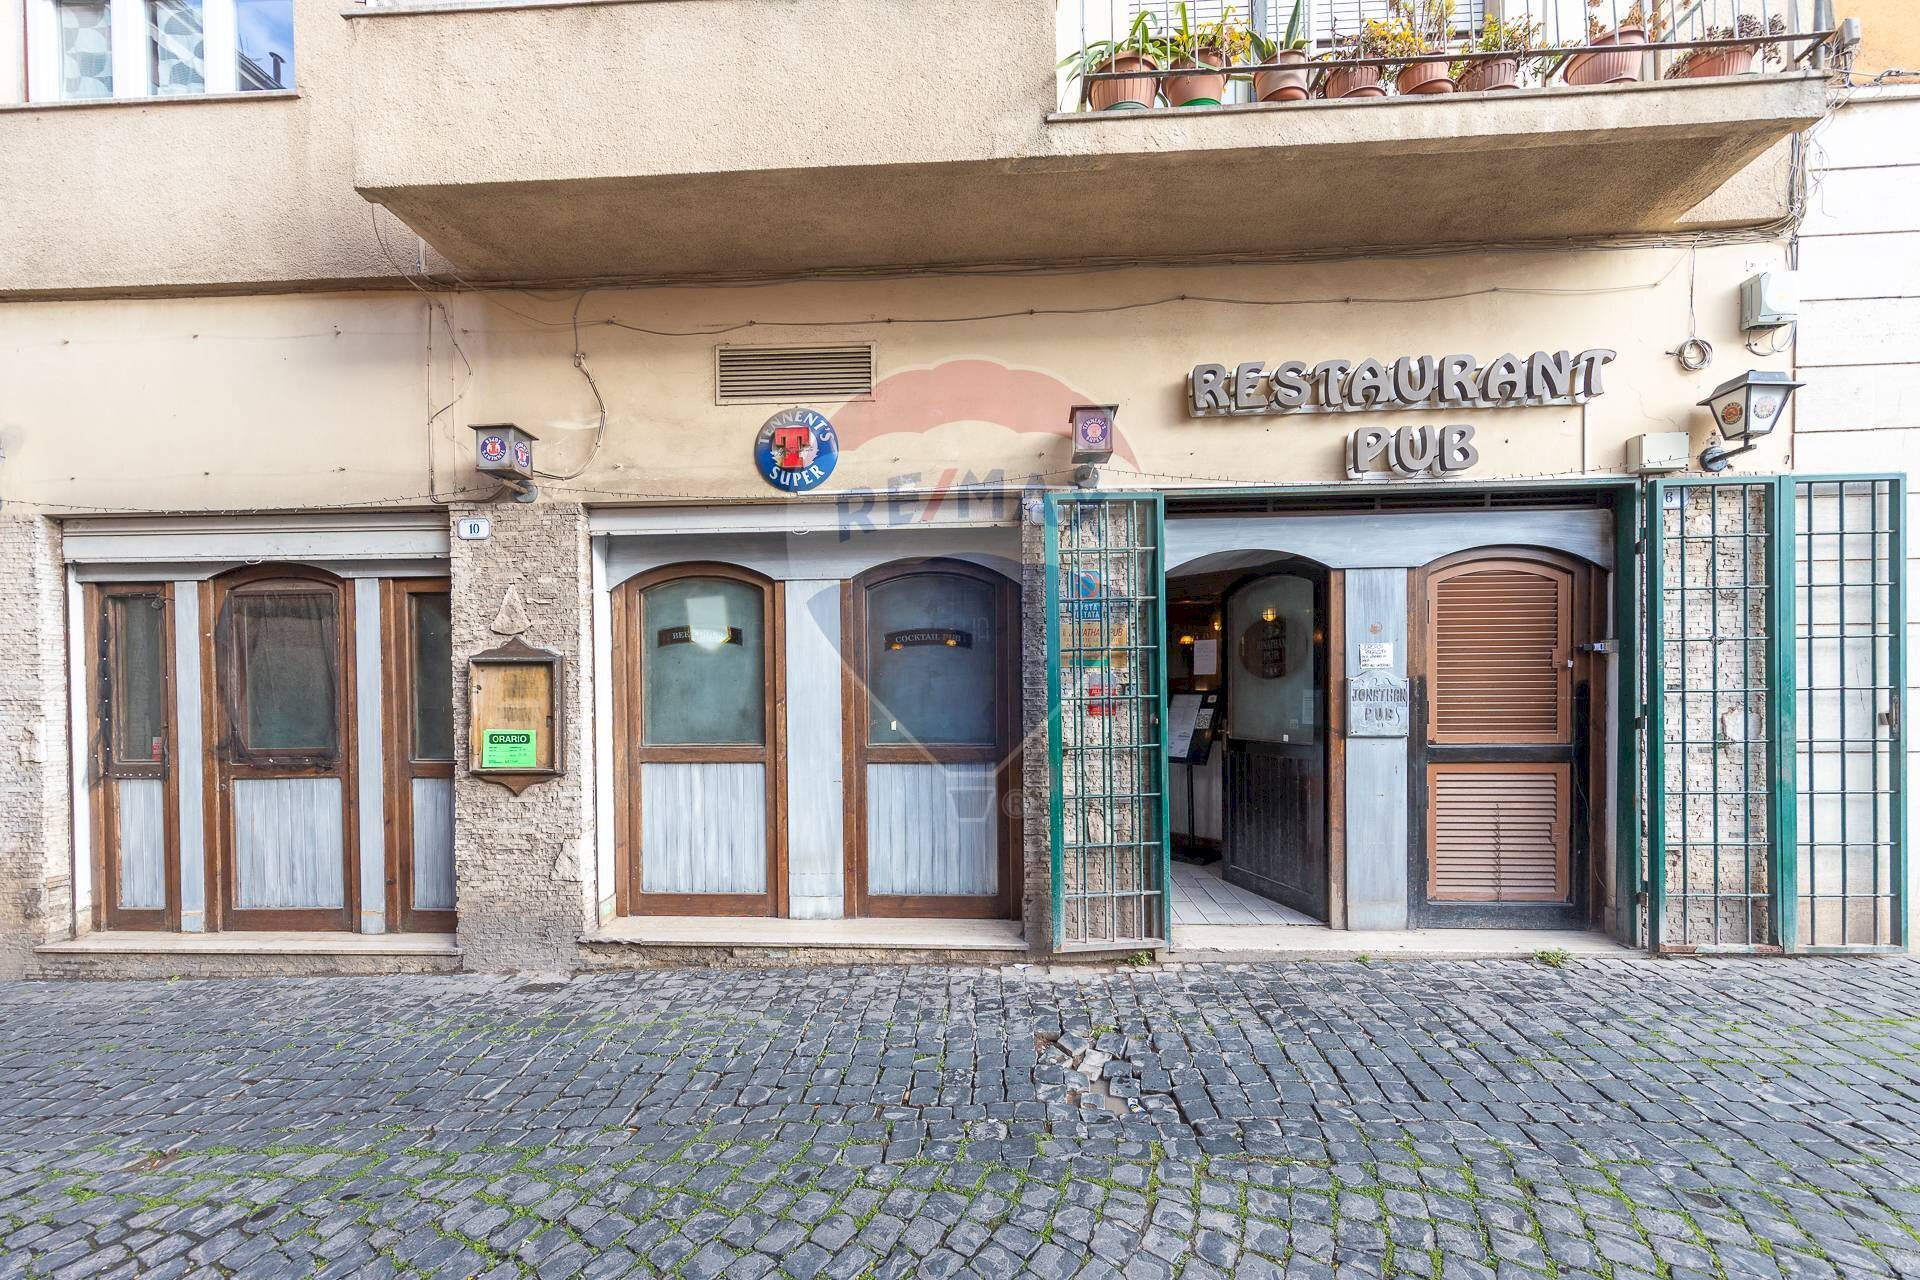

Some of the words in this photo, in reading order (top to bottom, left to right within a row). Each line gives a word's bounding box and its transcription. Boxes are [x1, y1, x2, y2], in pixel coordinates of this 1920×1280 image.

[1189, 349, 1617, 416] RESTAURANT
[758, 411, 834, 445] TENNENT'S
[1346, 424, 1480, 479] PUB
[769, 464, 826, 487] SUPER
[1665, 491, 1673, 503] 6
[469, 523, 480, 535] 10
[895, 634, 938, 643] COCKTAIL
[492, 735, 528, 744] ORARIO
